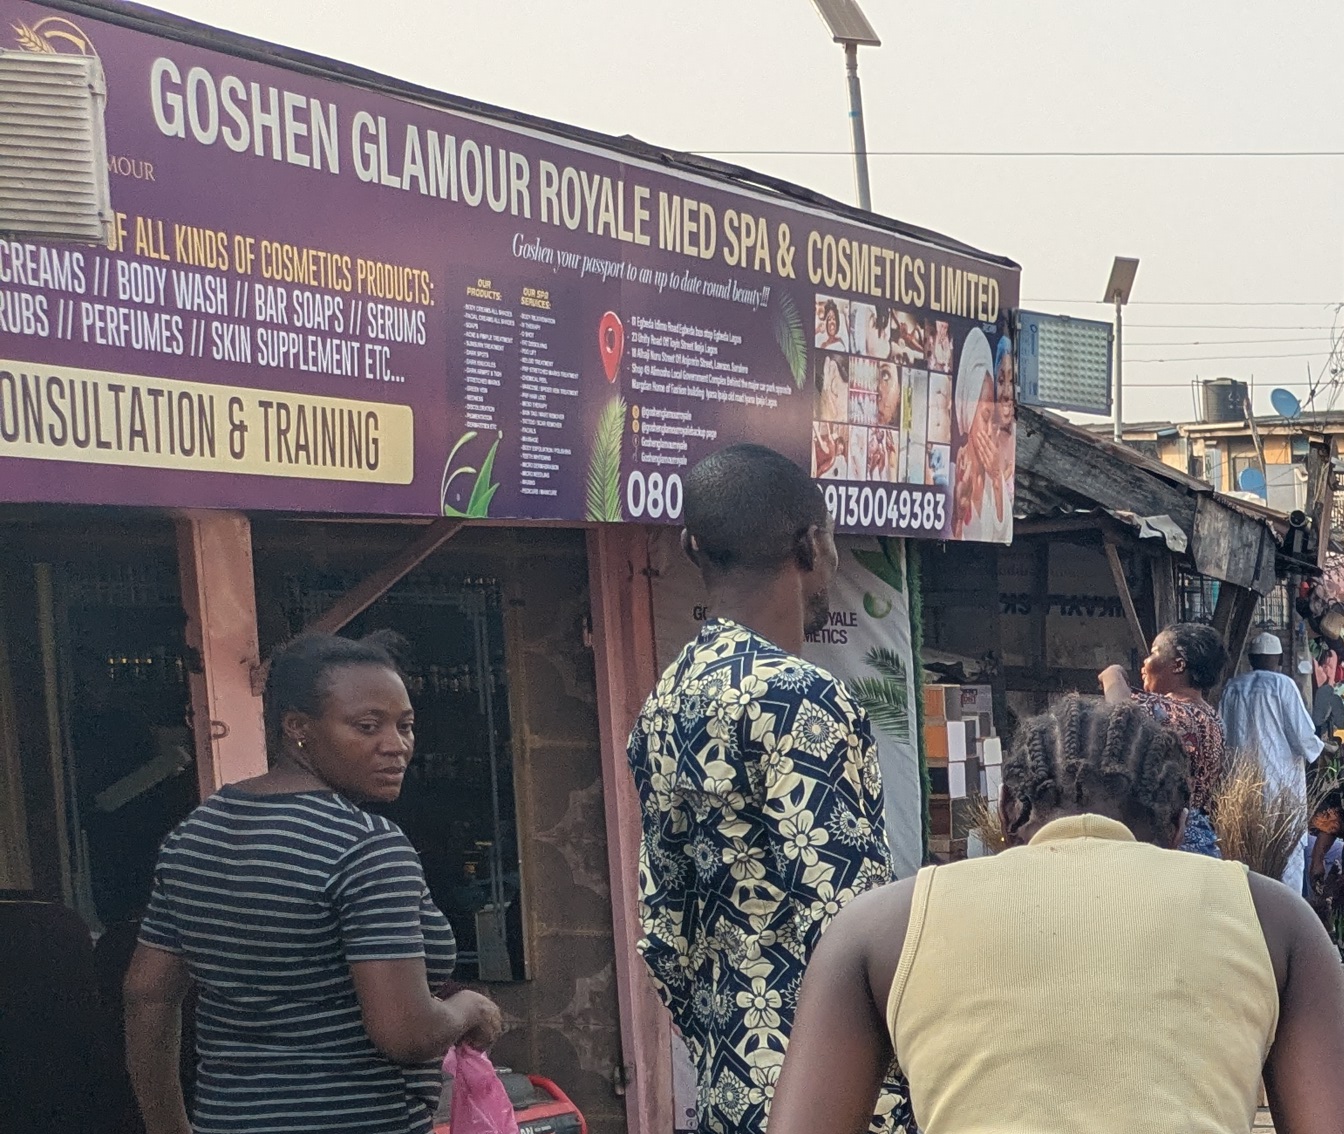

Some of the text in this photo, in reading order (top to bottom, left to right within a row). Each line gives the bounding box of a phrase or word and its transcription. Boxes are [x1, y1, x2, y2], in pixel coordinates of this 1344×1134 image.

[107, 158, 156, 182] MOUR
[150, 57, 1000, 324] GOSHEN GLAMOUR ROYALE MED SPA & COSMETICS LIMITED
[136, 216, 170, 261] ALL
[175, 223, 229, 271] KINDS
[234, 235, 255, 275] OF
[261, 240, 351, 292] COSMETICS
[357, 258, 435, 306] PRODUCTS:
[477, 278, 492, 289] OUR
[512, 232, 554, 264] Goshen
[553, 248, 582, 274] your
[580, 255, 626, 283] passport
[626, 260, 638, 282] to
[638, 266, 652, 284] an
[654, 269, 668, 294] up
[669, 269, 680, 290] to
[680, 269, 702, 292] date
[701, 276, 731, 301] round
[0, 239, 87, 294] CREAMS
[116, 259, 167, 306] BODY
[172, 269, 228, 316] WASH
[255, 283, 288, 325] BAR
[293, 290, 344, 334] SOAPS
[367, 302, 427, 345] SERUMS
[523, 287, 536, 298] OUR
[81, 301, 184, 356] PERFUMES
[212, 320, 252, 364] SKIN
[257, 327, 360, 378] SUPPLEMENT
[365, 343, 405, 383] ETC...
[228, 395, 249, 460] &
[259, 398, 380, 473] TRAINING
[824, 485, 947, 530] 9130049383
[804, 629, 848, 645] METICS
[827, 611, 858, 627] YALE
